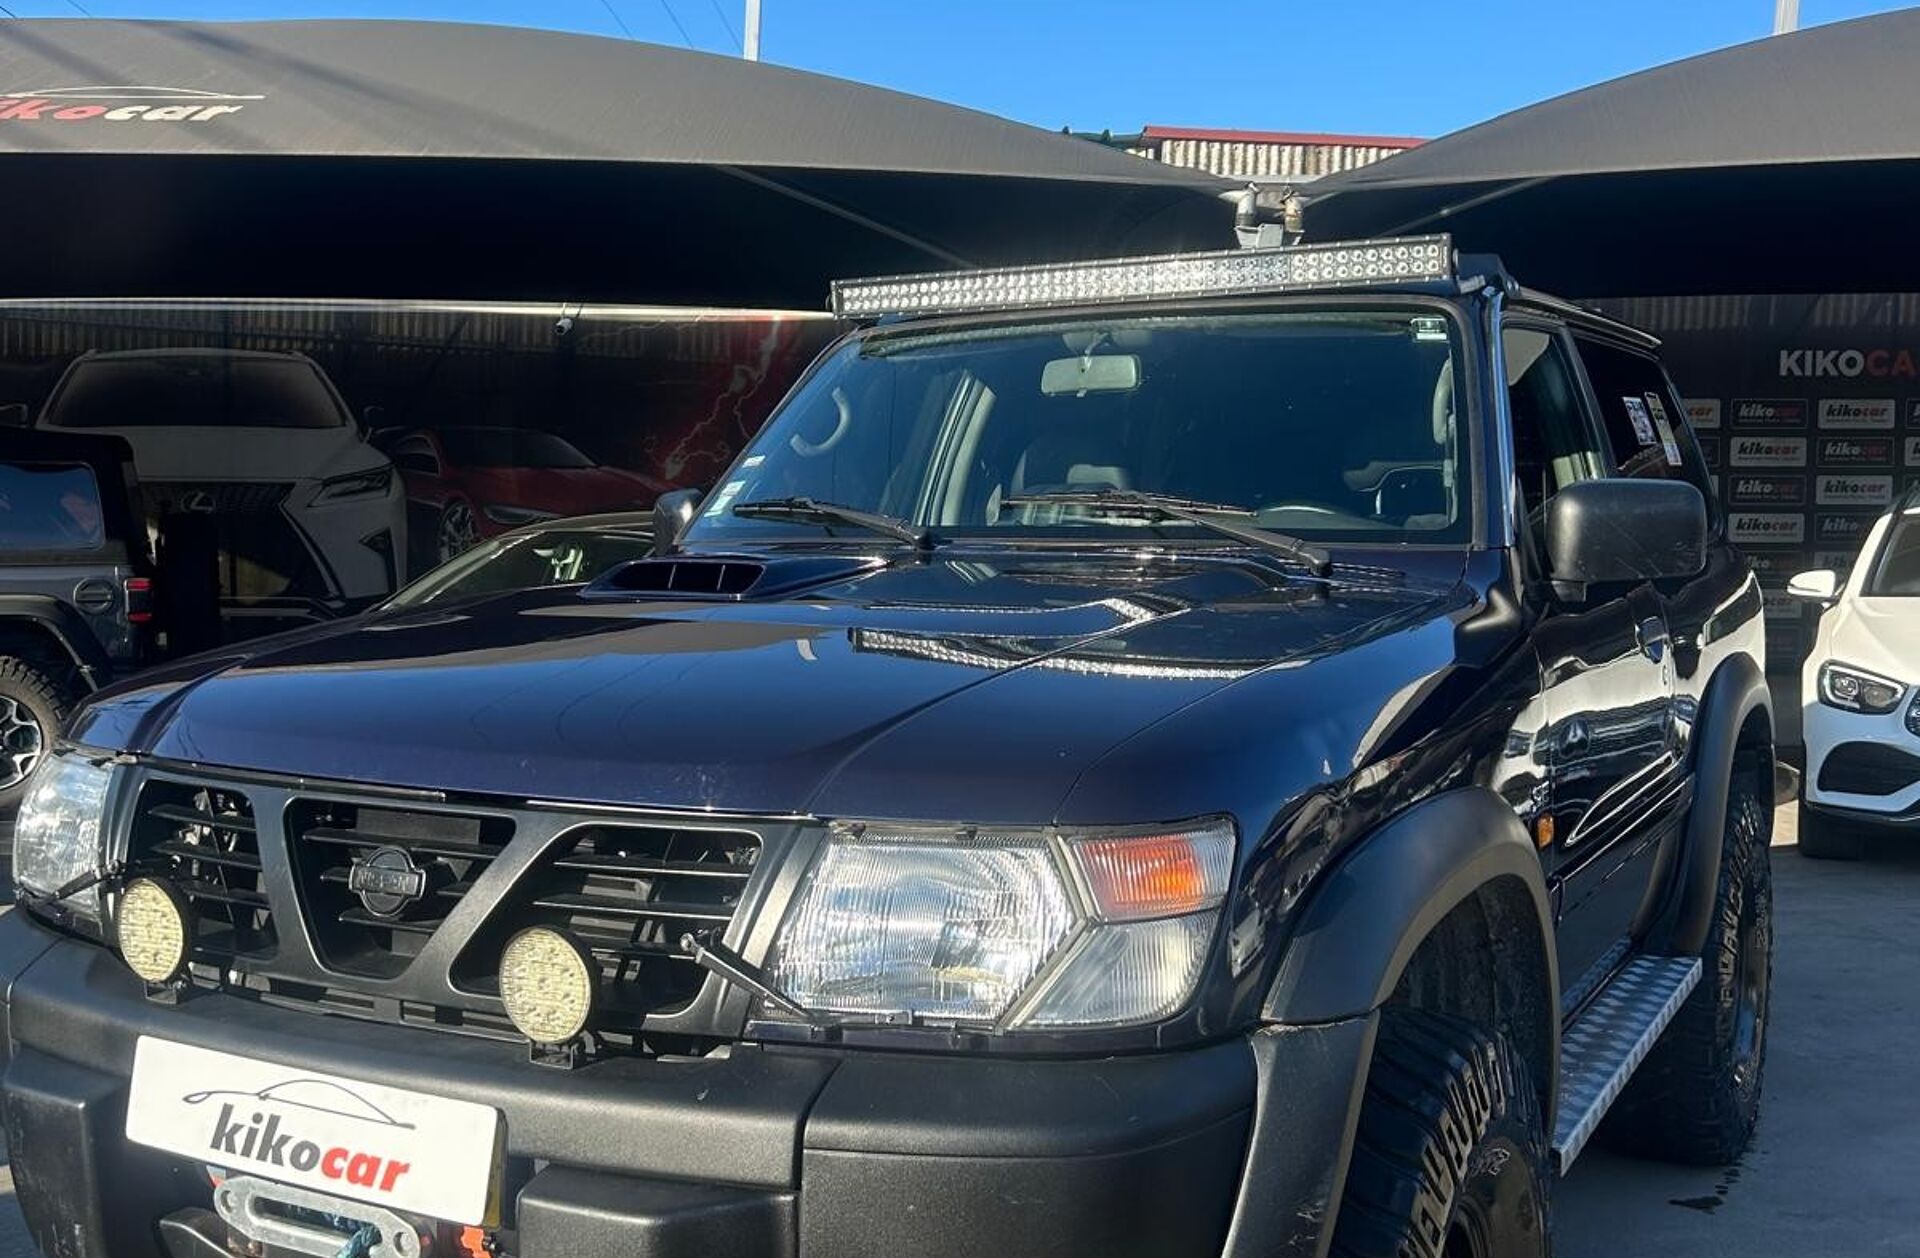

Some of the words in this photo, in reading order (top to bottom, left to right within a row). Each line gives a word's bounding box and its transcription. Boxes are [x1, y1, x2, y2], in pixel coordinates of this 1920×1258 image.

[1826, 404, 1887, 417] kikocar
[1738, 442, 1800, 455] kikocar
[1825, 442, 1886, 456] kiko
[1736, 480, 1797, 494] kiko
[1824, 480, 1885, 493] kikocar
[1736, 518, 1797, 531] kikocar
[210, 1104, 410, 1192] kikocar
